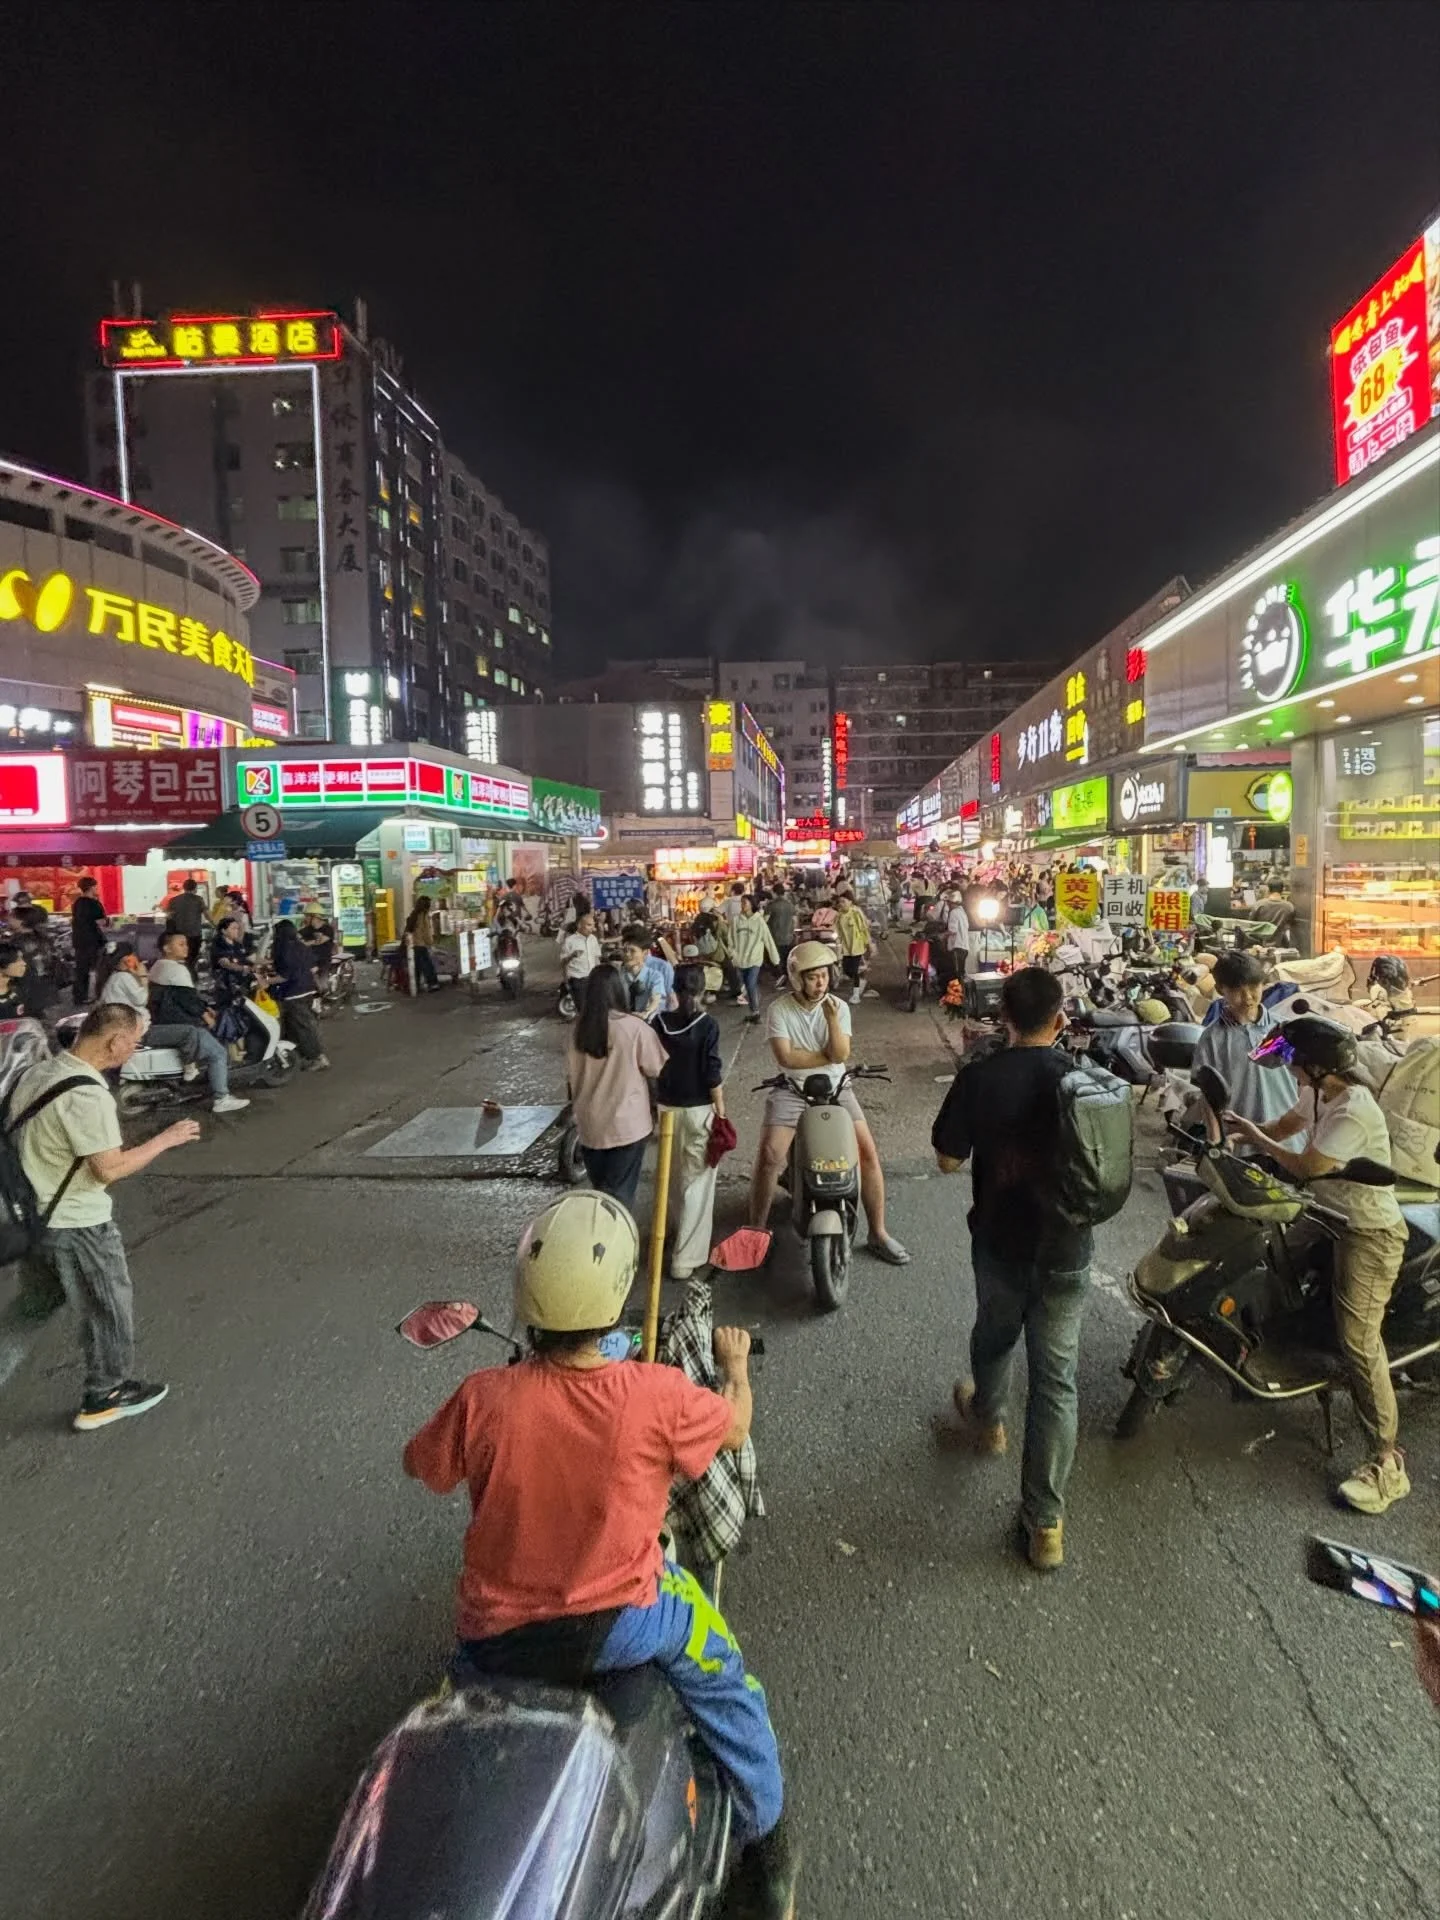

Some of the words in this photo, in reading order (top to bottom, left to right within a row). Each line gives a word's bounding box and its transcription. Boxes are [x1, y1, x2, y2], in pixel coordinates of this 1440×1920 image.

[1352, 323, 1400, 376] 纸包鱼
[1359, 362, 1386, 415] 68
[74, 759, 218, 805] 阿琴包点
[255, 811, 271, 833] 5
[1062, 878, 1094, 913] 黄金
[1106, 877, 1145, 896] 手机
[1106, 900, 1145, 917] 回收
[1152, 891, 1181, 931] 照相
